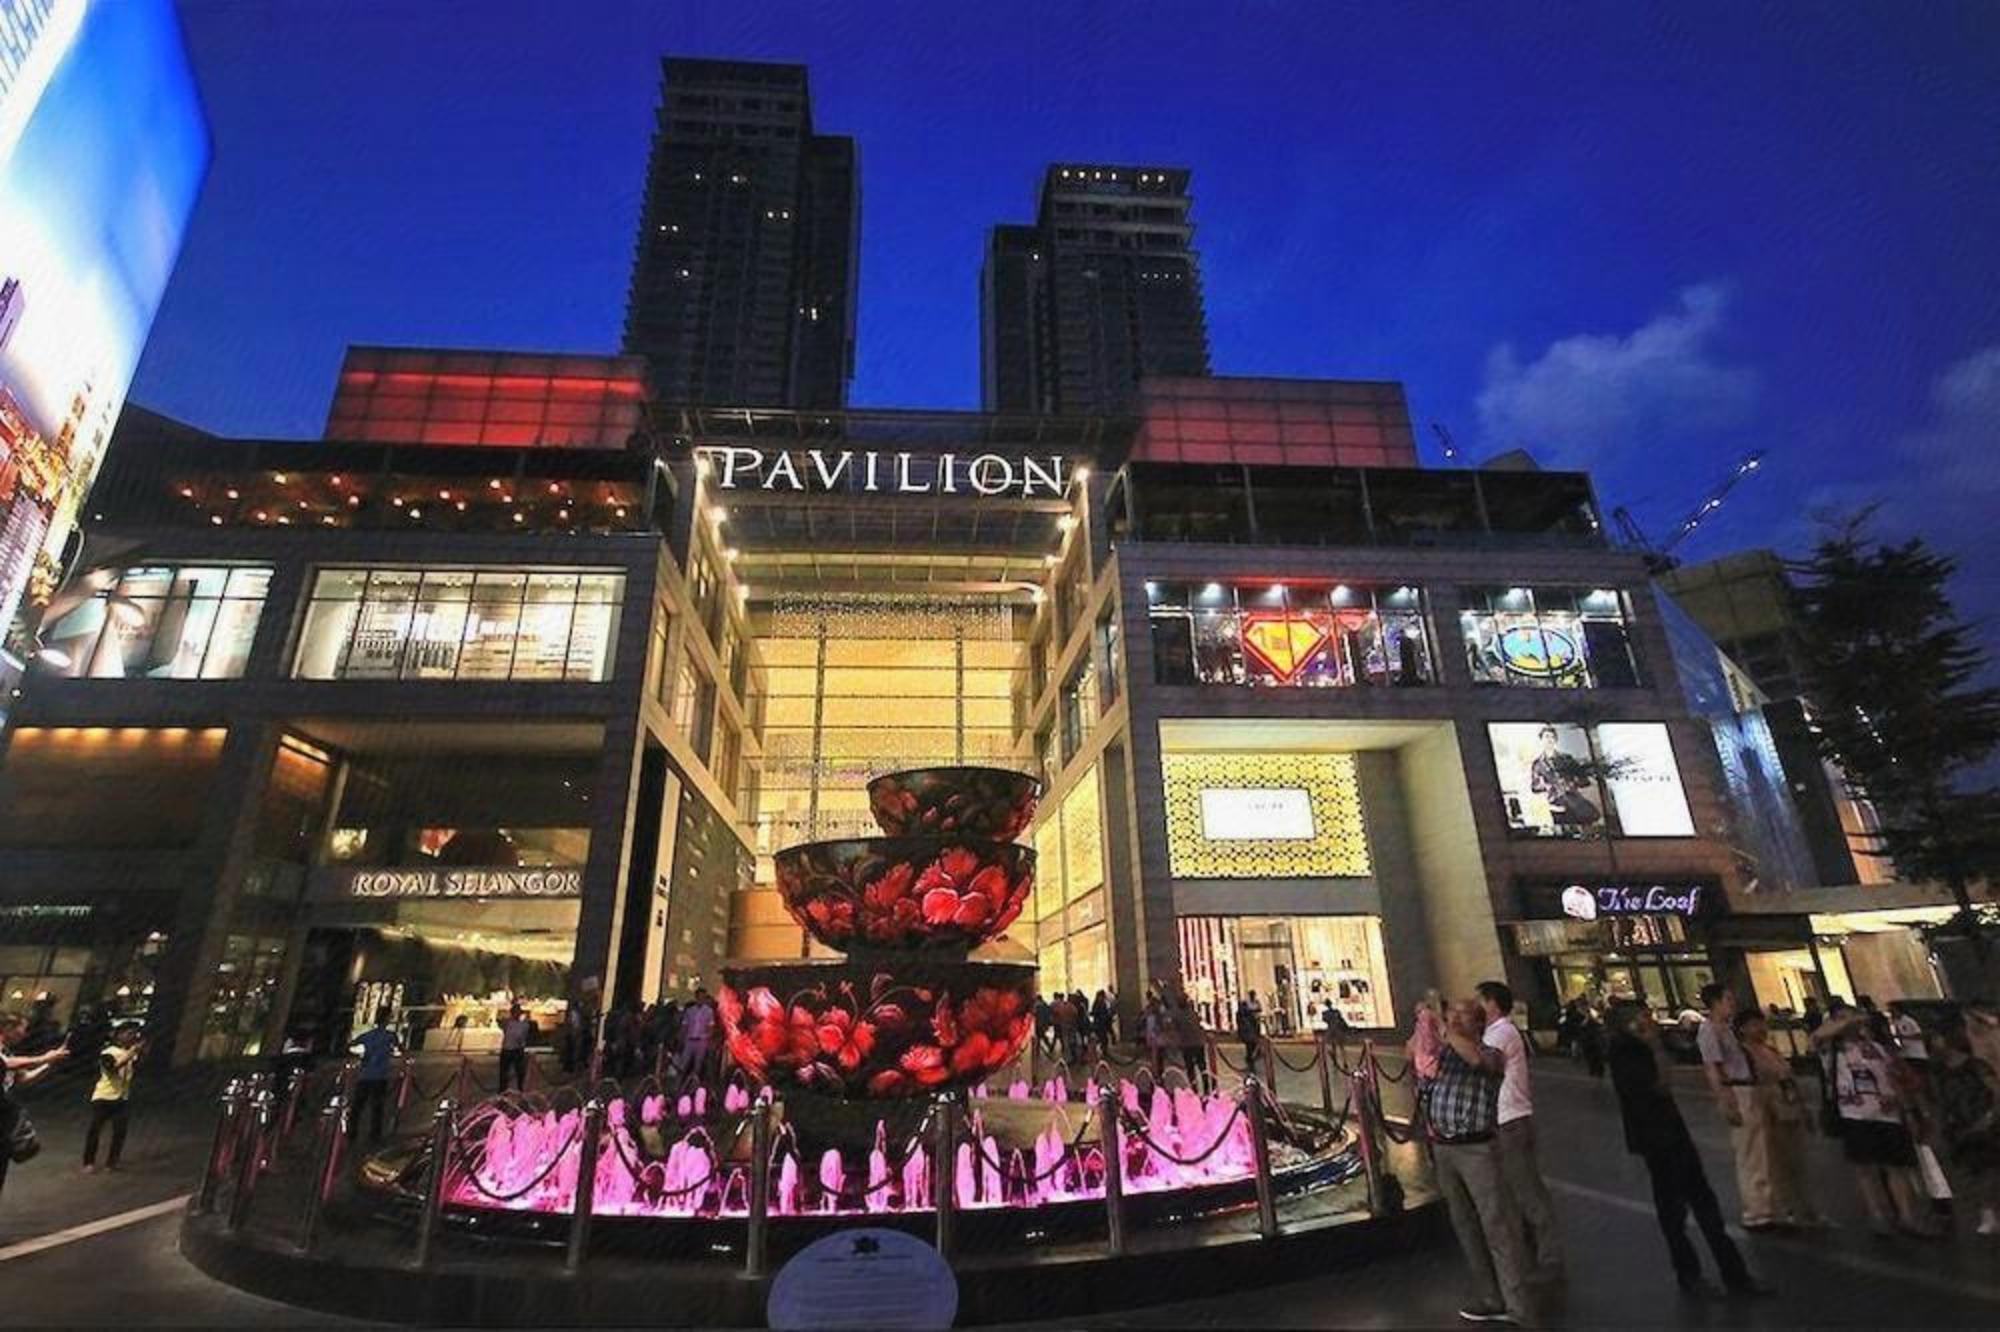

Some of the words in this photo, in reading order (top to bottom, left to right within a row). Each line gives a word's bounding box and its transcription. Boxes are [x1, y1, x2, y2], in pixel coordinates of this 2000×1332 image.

[704, 448, 1064, 497] PAVILION
[353, 871, 441, 897] ROYAL
[444, 870, 581, 896] SELANGOR
